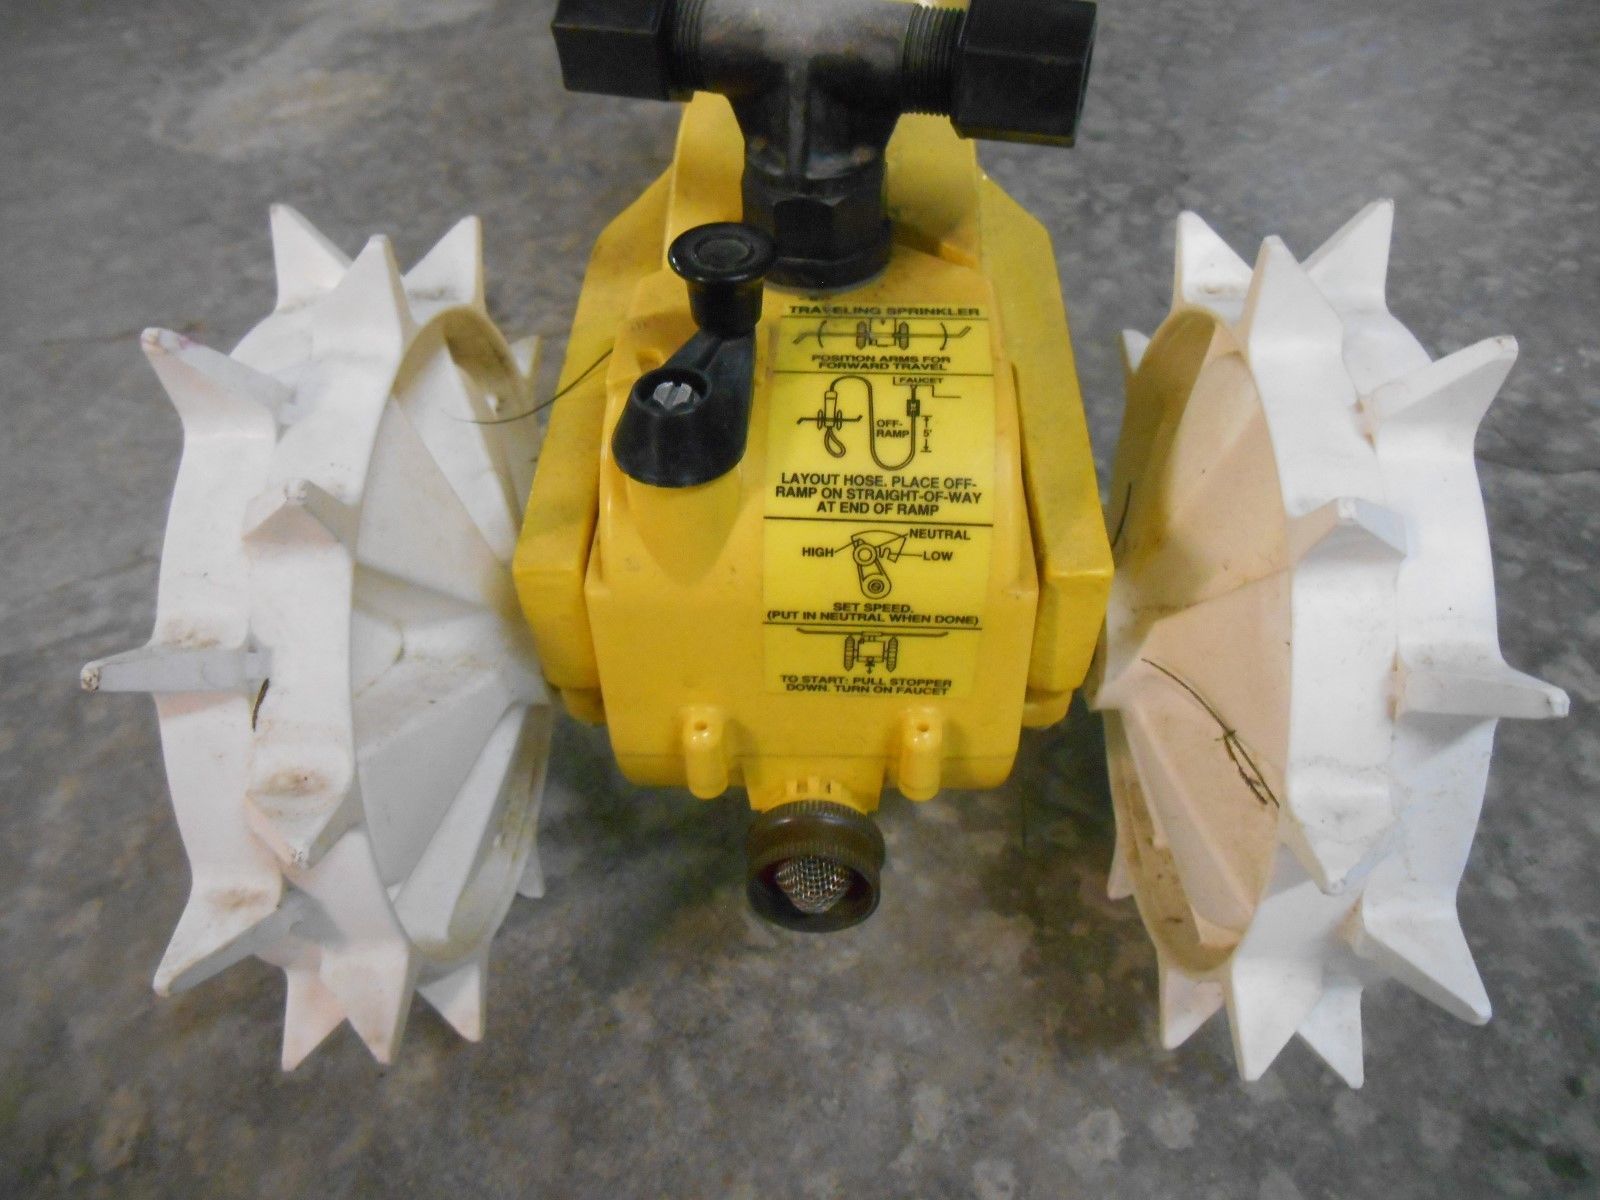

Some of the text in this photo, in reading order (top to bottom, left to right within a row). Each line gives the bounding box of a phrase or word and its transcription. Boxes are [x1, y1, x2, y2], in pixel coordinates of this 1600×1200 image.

[789, 305, 980, 316] TRAVELING SPRINKLER
[880, 355, 918, 363] ARMS
[818, 361, 948, 371] FORWARD TRAVEL
[876, 419, 903, 428] OFF-
[876, 429, 910, 438] RAMP
[781, 472, 977, 489] LAYOUT HOSE. PLACE OFF-
[776, 485, 982, 505] RAMP ON STRAIGHT-OF-WAY
[816, 501, 940, 516] AT END OF RAMP
[909, 528, 971, 541] NEUTRAL
[802, 547, 834, 558] HIGH
[923, 551, 953, 561] LOW
[833, 602, 914, 614] SET SPEED.
[767, 610, 979, 626] (PUT IN NEUTRAL WHEN DONE)
[780, 674, 798, 683] TO
[853, 677, 887, 686] PULL
[890, 679, 953, 688] STOPPER
[835, 685, 870, 693] TURN
[873, 686, 893, 694] ON
[896, 686, 947, 695] FAUCET
